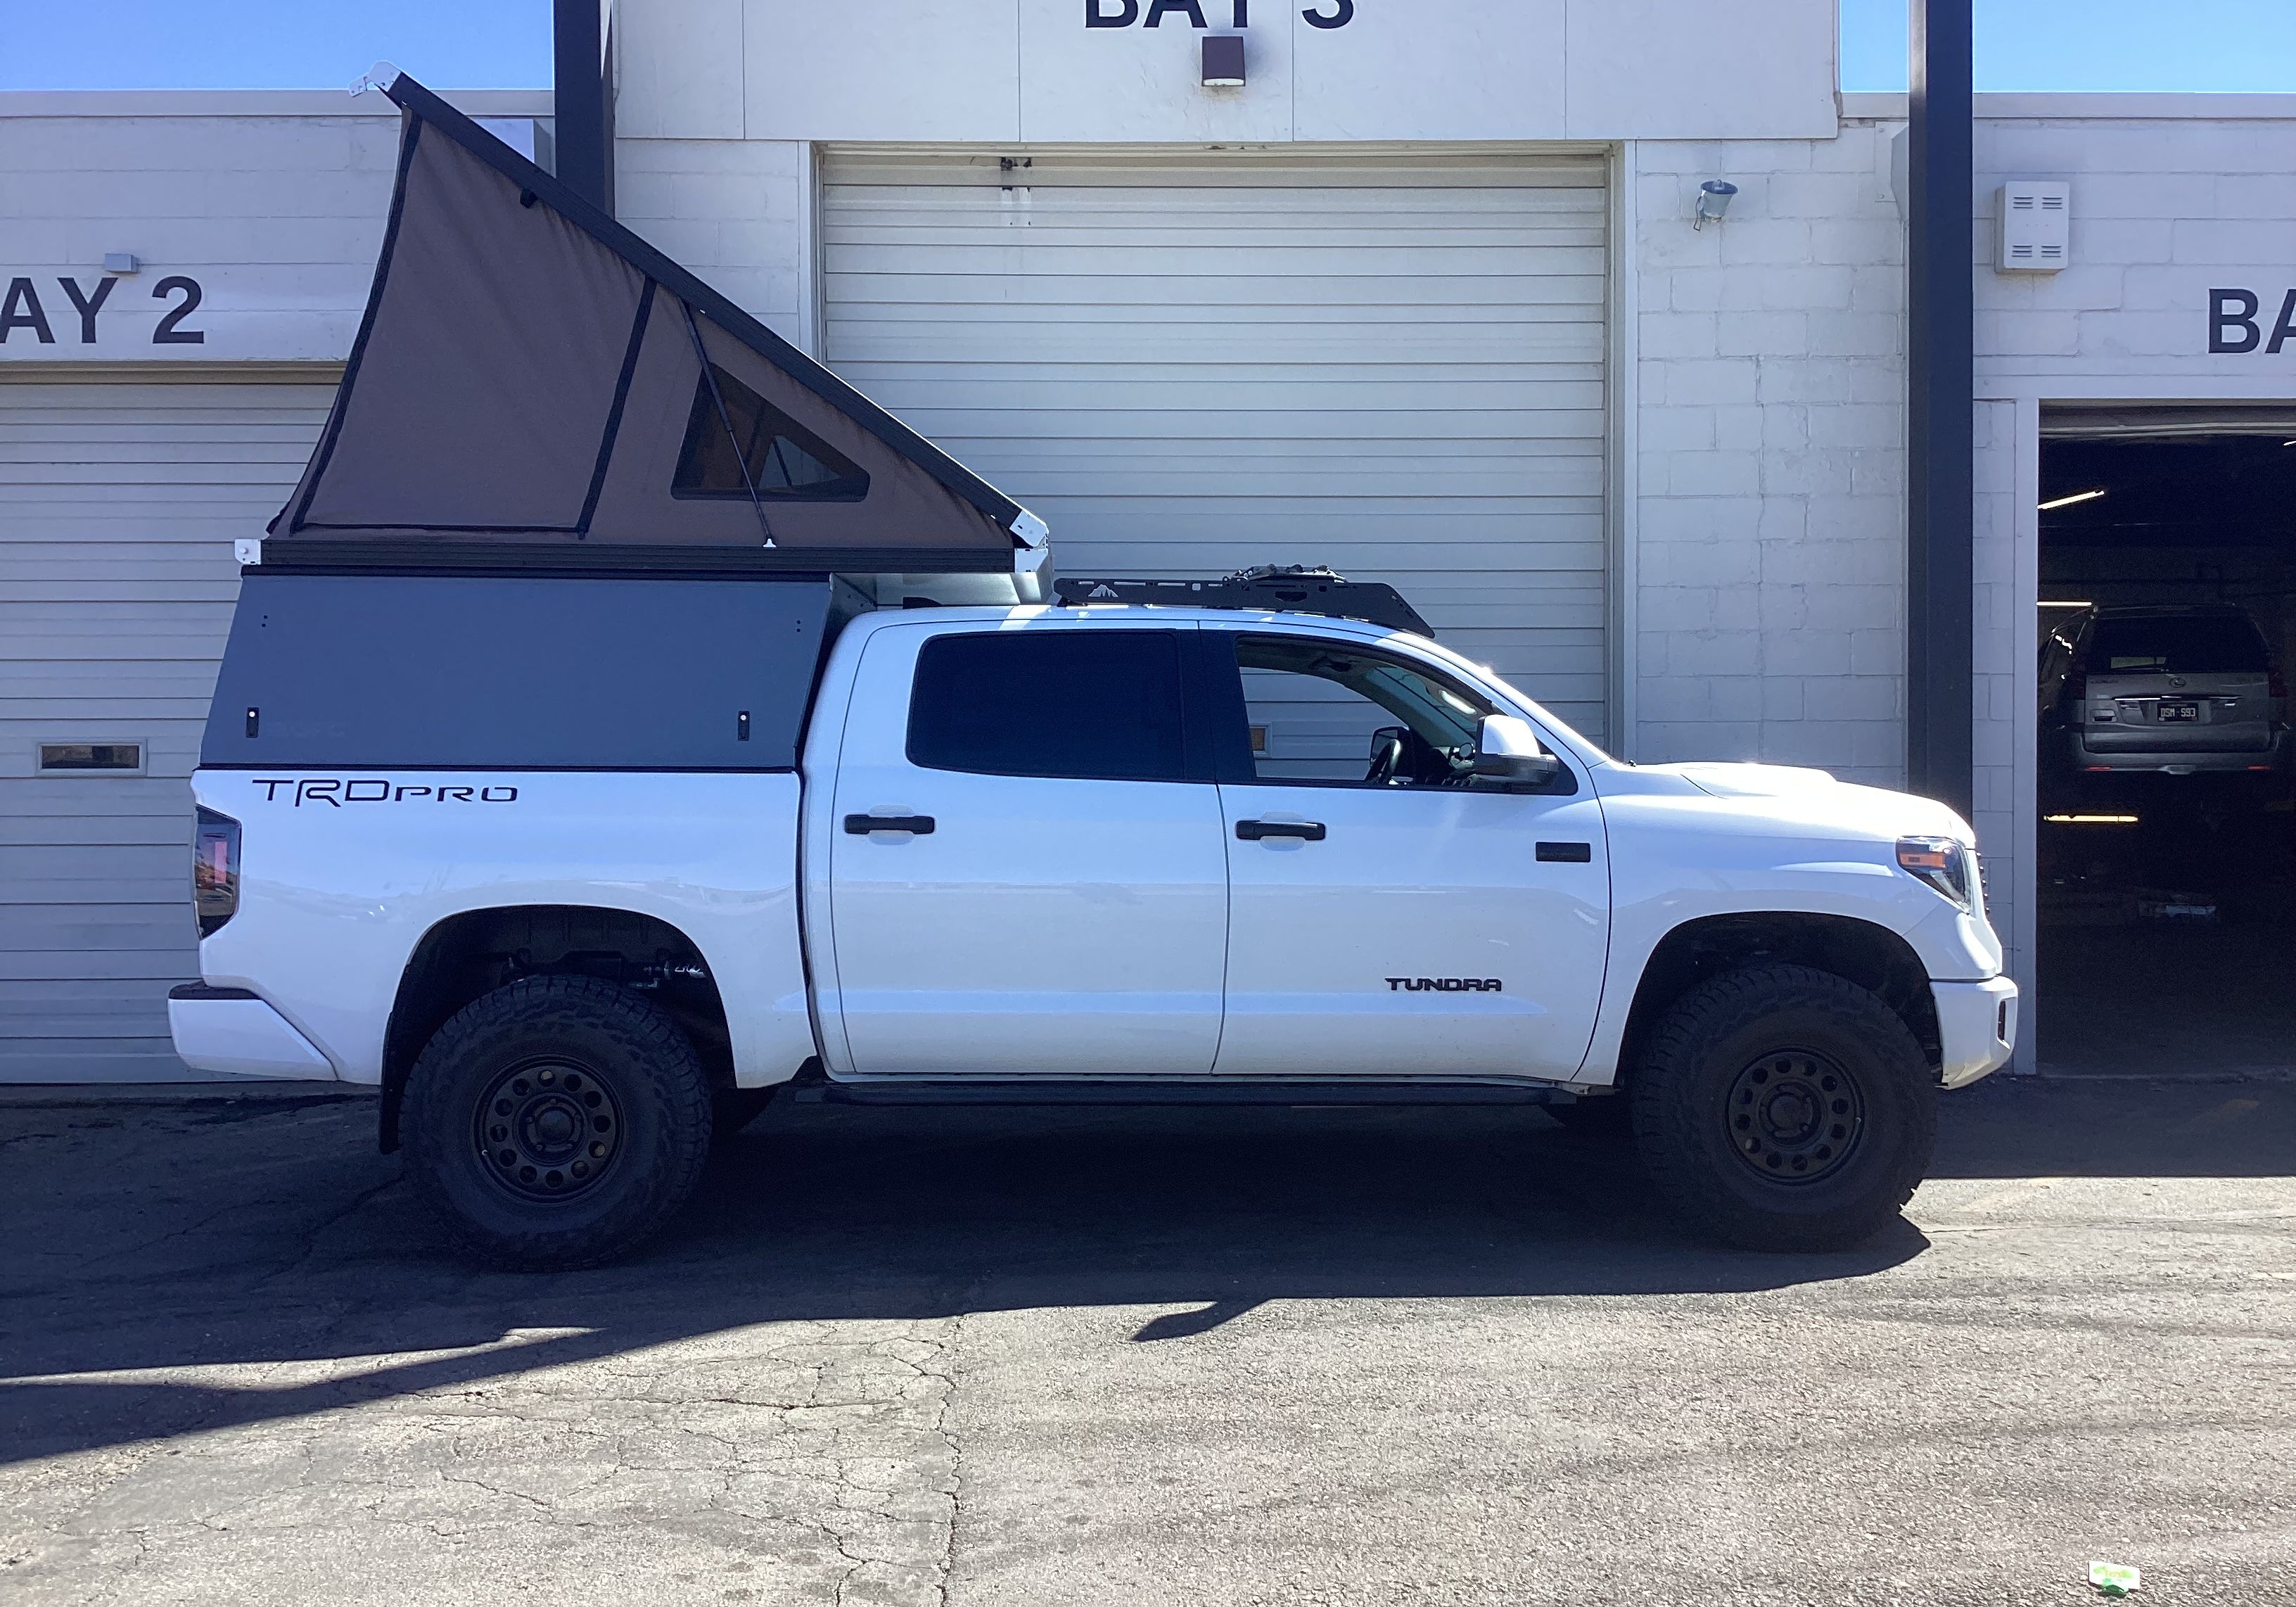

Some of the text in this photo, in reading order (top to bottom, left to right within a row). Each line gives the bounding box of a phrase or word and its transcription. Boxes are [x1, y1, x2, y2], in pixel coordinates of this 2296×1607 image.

[0, 275, 205, 344] AY 2
[251, 779, 518, 807] TRD PRO
[1384, 977, 1503, 991] TUNDRA
